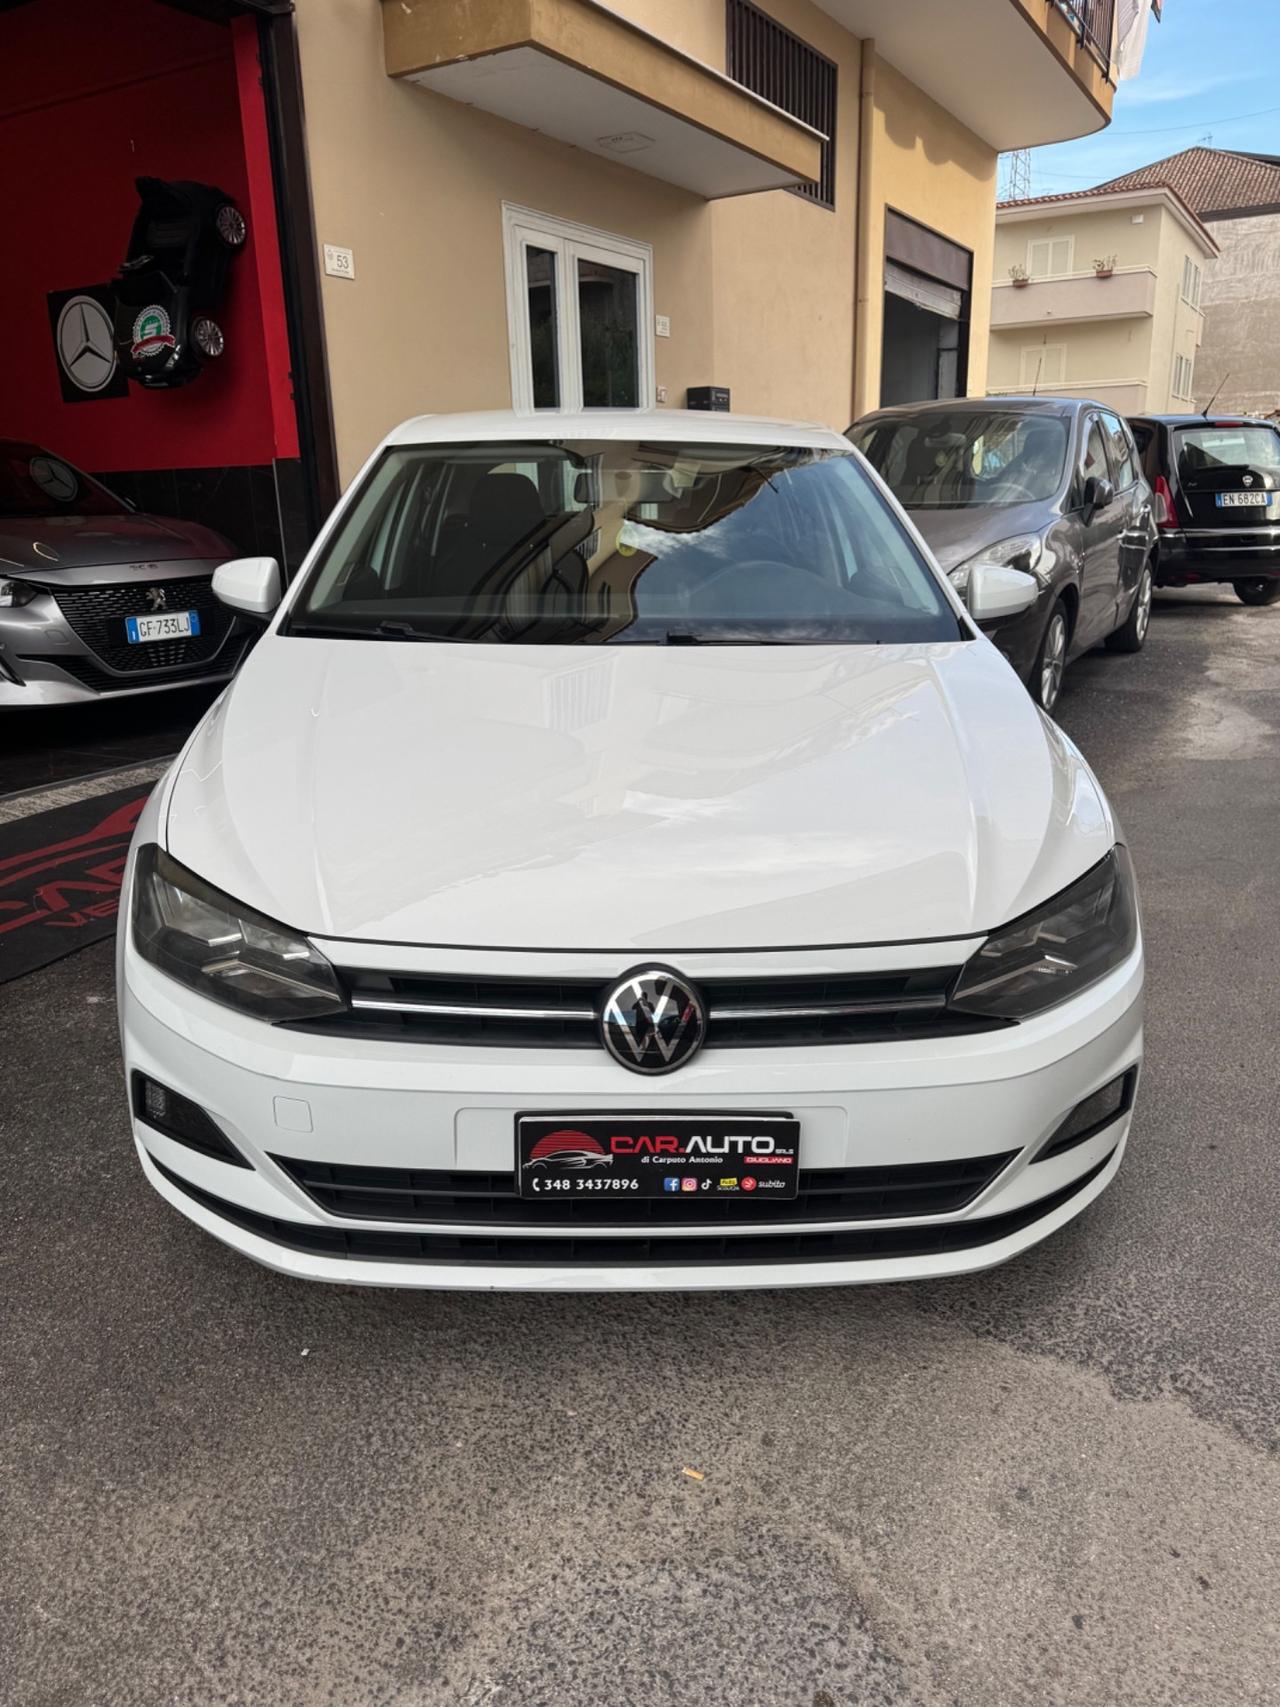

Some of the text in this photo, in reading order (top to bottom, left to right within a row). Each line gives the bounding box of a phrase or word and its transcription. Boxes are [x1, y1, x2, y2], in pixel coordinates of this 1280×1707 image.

[336, 254, 349, 269] 53
[1223, 494, 1235, 505] EN
[641, 1155, 650, 1163] di
[544, 1179, 639, 1190] 348 3437896
[758, 1180, 786, 1189] subito
